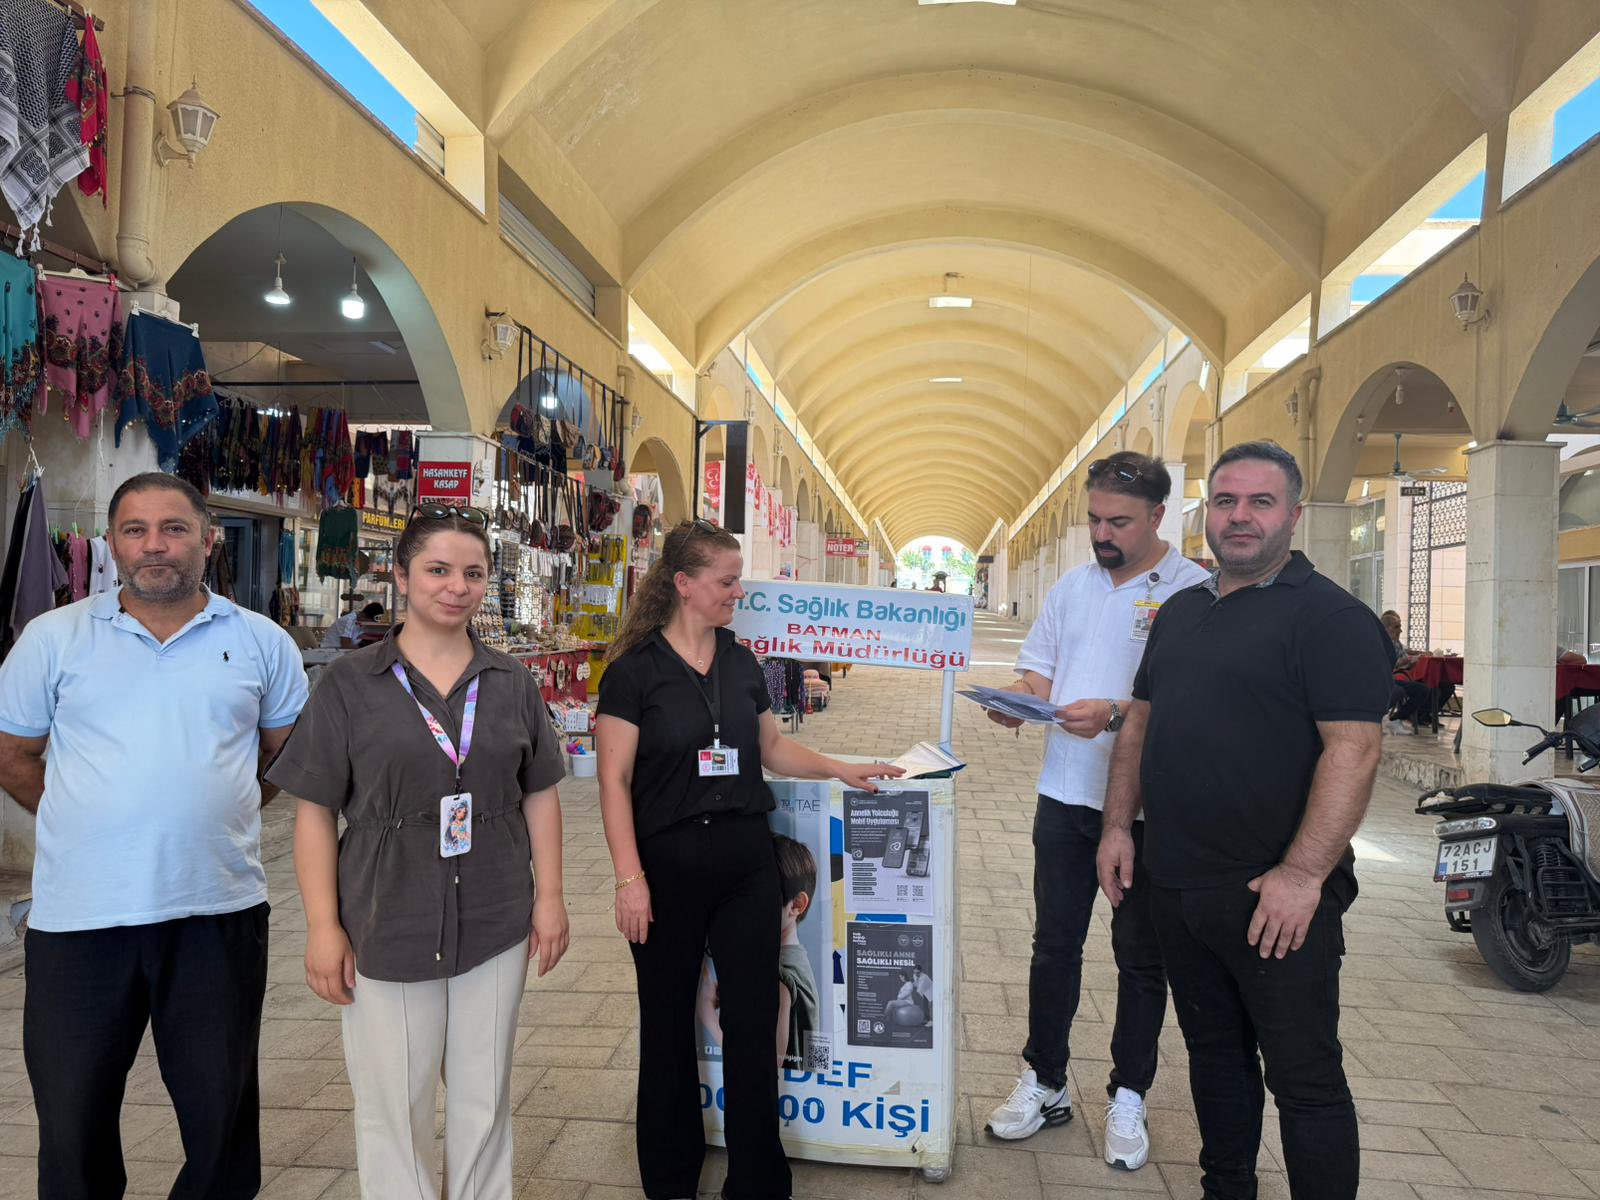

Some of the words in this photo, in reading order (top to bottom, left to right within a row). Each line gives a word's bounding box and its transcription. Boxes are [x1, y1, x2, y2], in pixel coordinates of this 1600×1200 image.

[423, 468, 468, 479] HASANKEYF
[434, 480, 459, 489] KASAP
[827, 543, 854, 552] NOTER
[778, 594, 850, 621] Sağlık
[856, 600, 966, 632] Bakanlığı
[787, 623, 881, 641] BATMAN
[813, 640, 965, 669] Müdürlüğü
[1452, 858, 1479, 873] 151
[856, 949, 892, 958] SAĞLIKLI
[893, 951, 916, 959] ANNE
[856, 957, 892, 966] SAĞLIKLI
[842, 1096, 930, 1138] KİŞİ
